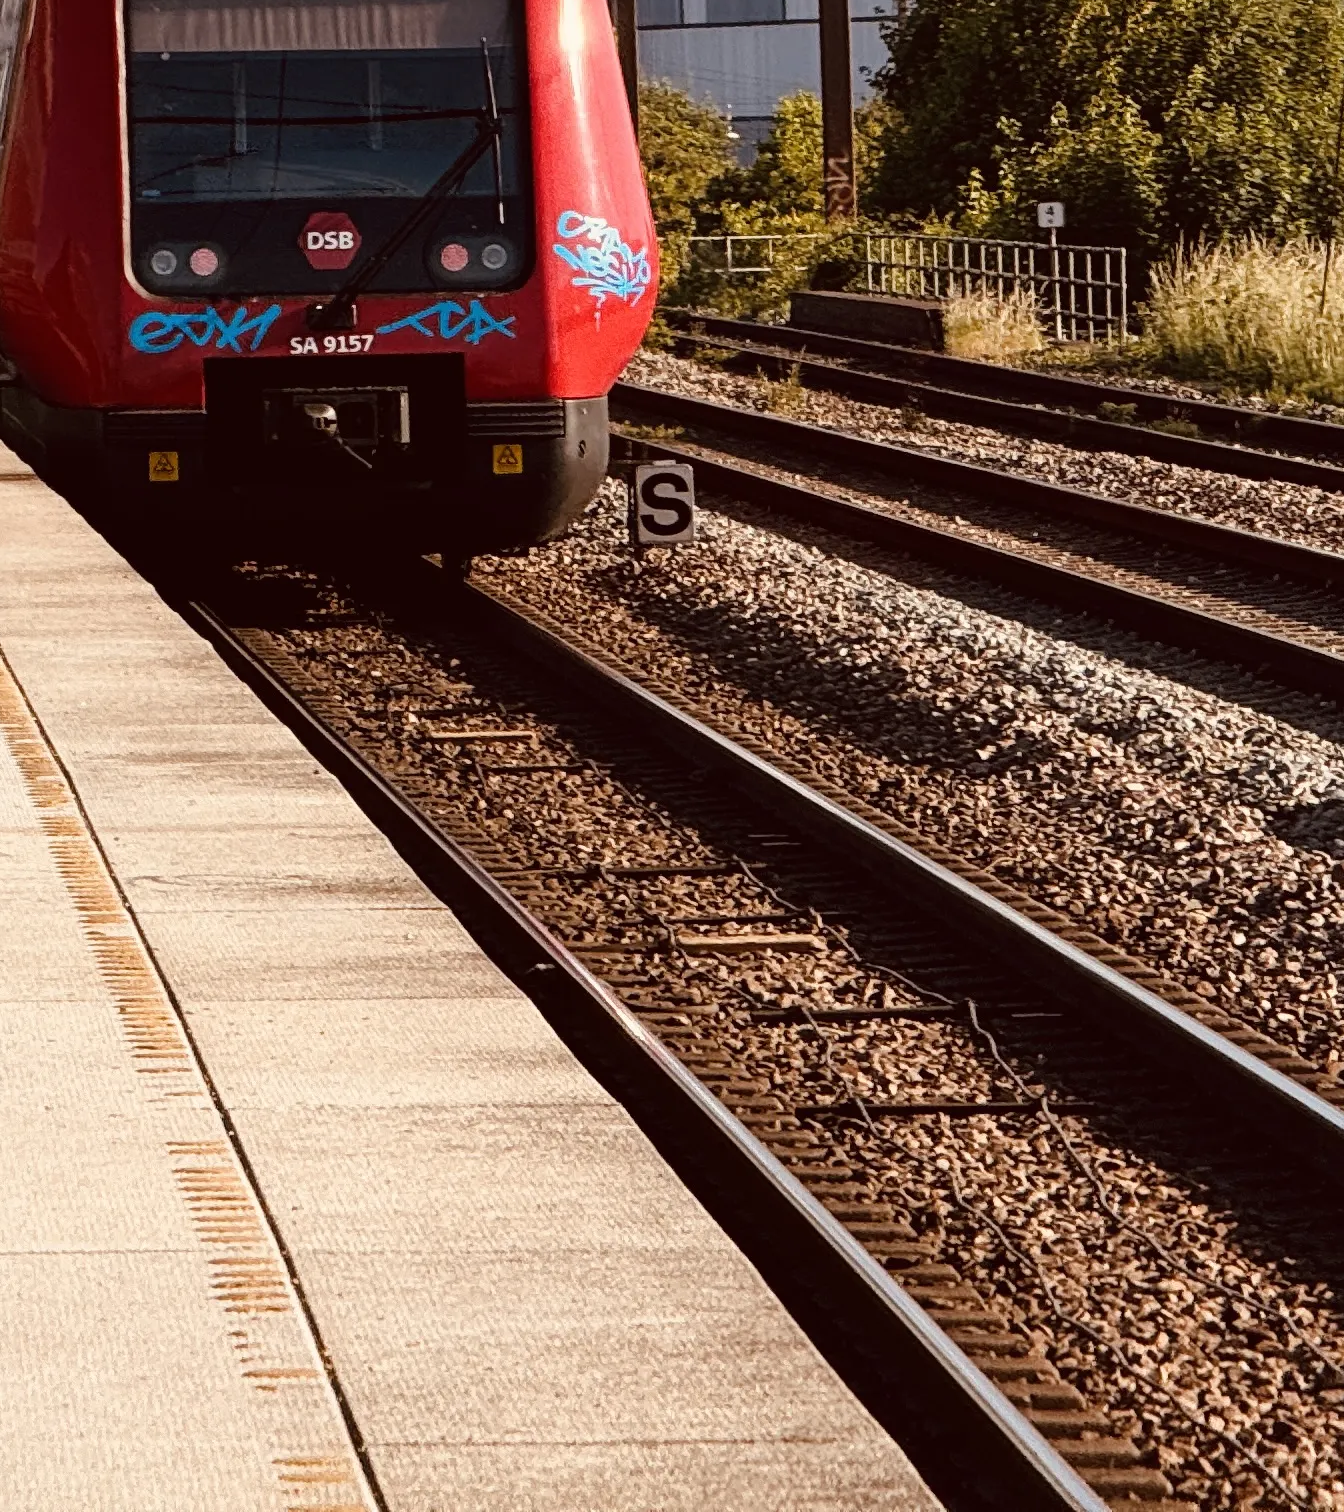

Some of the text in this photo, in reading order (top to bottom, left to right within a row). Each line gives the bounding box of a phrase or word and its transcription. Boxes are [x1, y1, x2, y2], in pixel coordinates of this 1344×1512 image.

[306, 231, 354, 250] DSB
[289, 334, 374, 355] SA 9157
[640, 472, 691, 536] S
